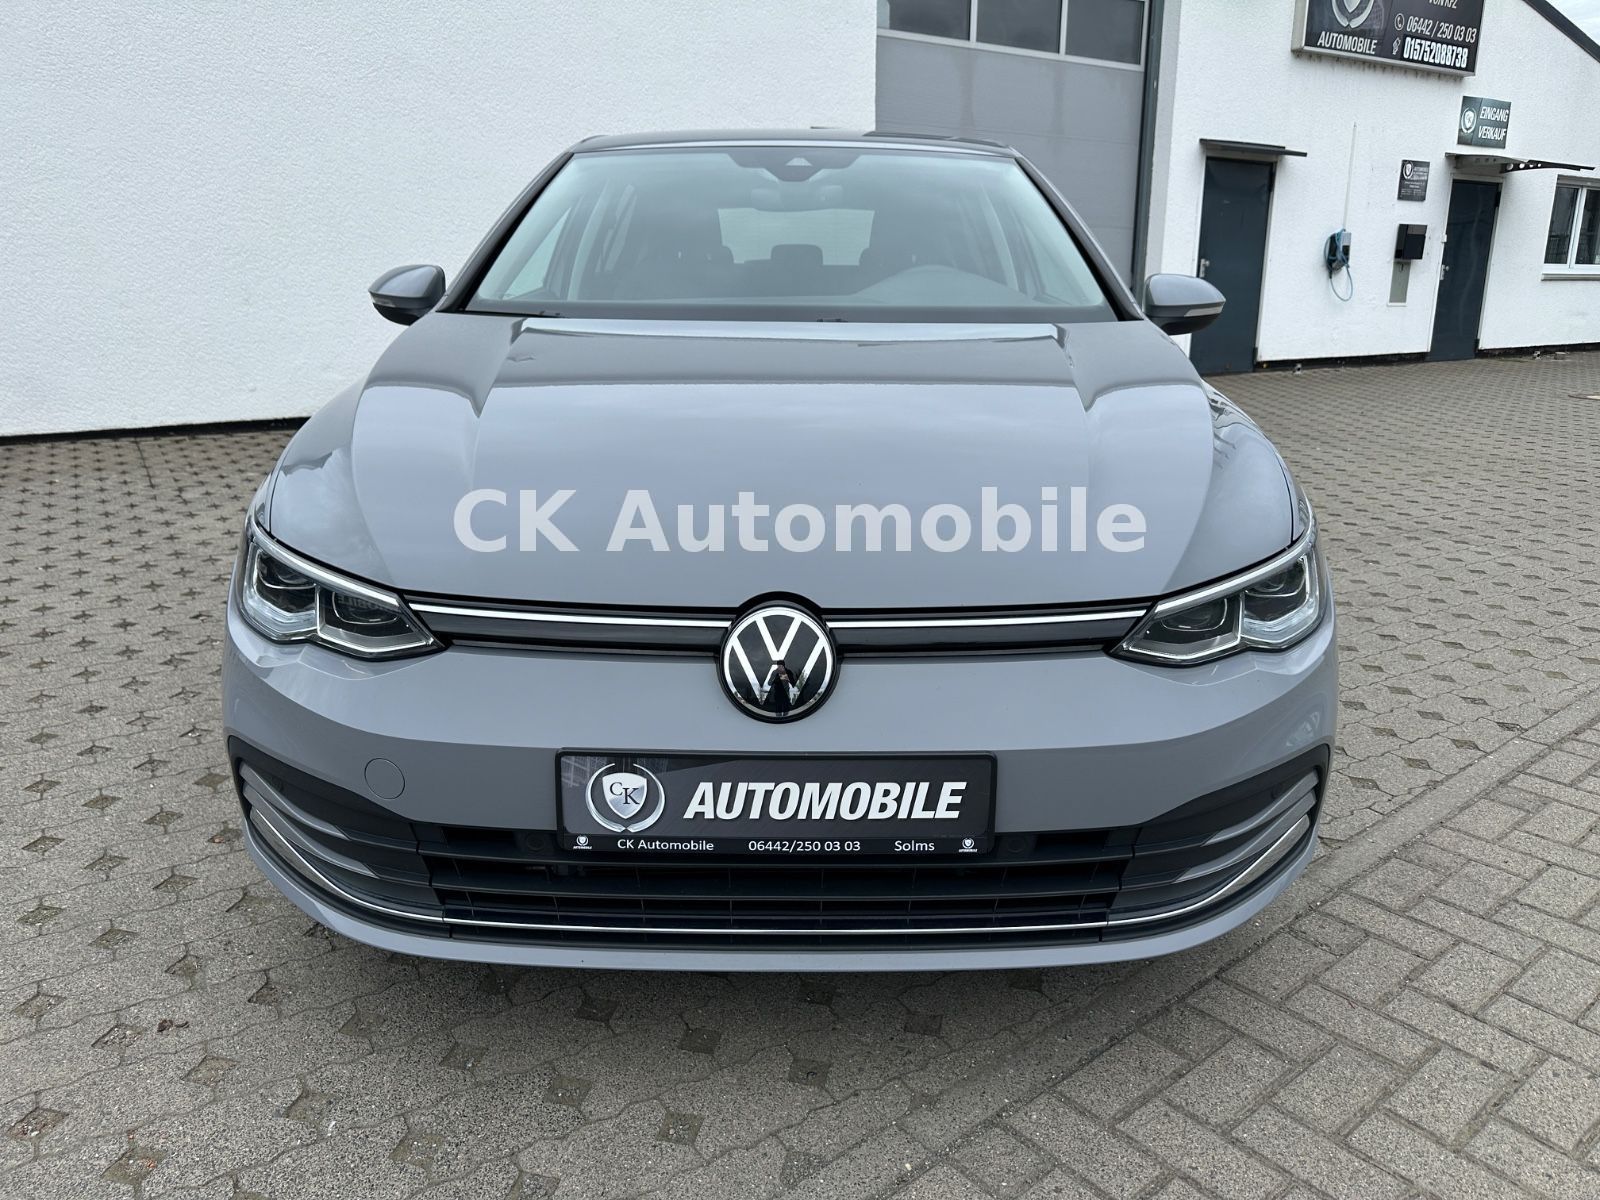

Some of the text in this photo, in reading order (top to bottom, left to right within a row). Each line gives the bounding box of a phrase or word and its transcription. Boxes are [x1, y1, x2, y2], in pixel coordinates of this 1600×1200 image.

[1406, 15, 1433, 36] 06442
[1437, 22, 1454, 40] 250
[1453, 25, 1466, 42] 03
[1465, 27, 1477, 43] 03
[1317, 31, 1378, 55] AUTOMOBILE
[1403, 36, 1469, 68] 015752088738
[1480, 106, 1509, 122] EINGANG
[1478, 125, 1507, 141] VERKAUF
[609, 781, 640, 805] CK
[682, 781, 968, 821] AUTOMOBILE
[617, 839, 935, 853] CK Automobile 06442/250 03 03 Solms
